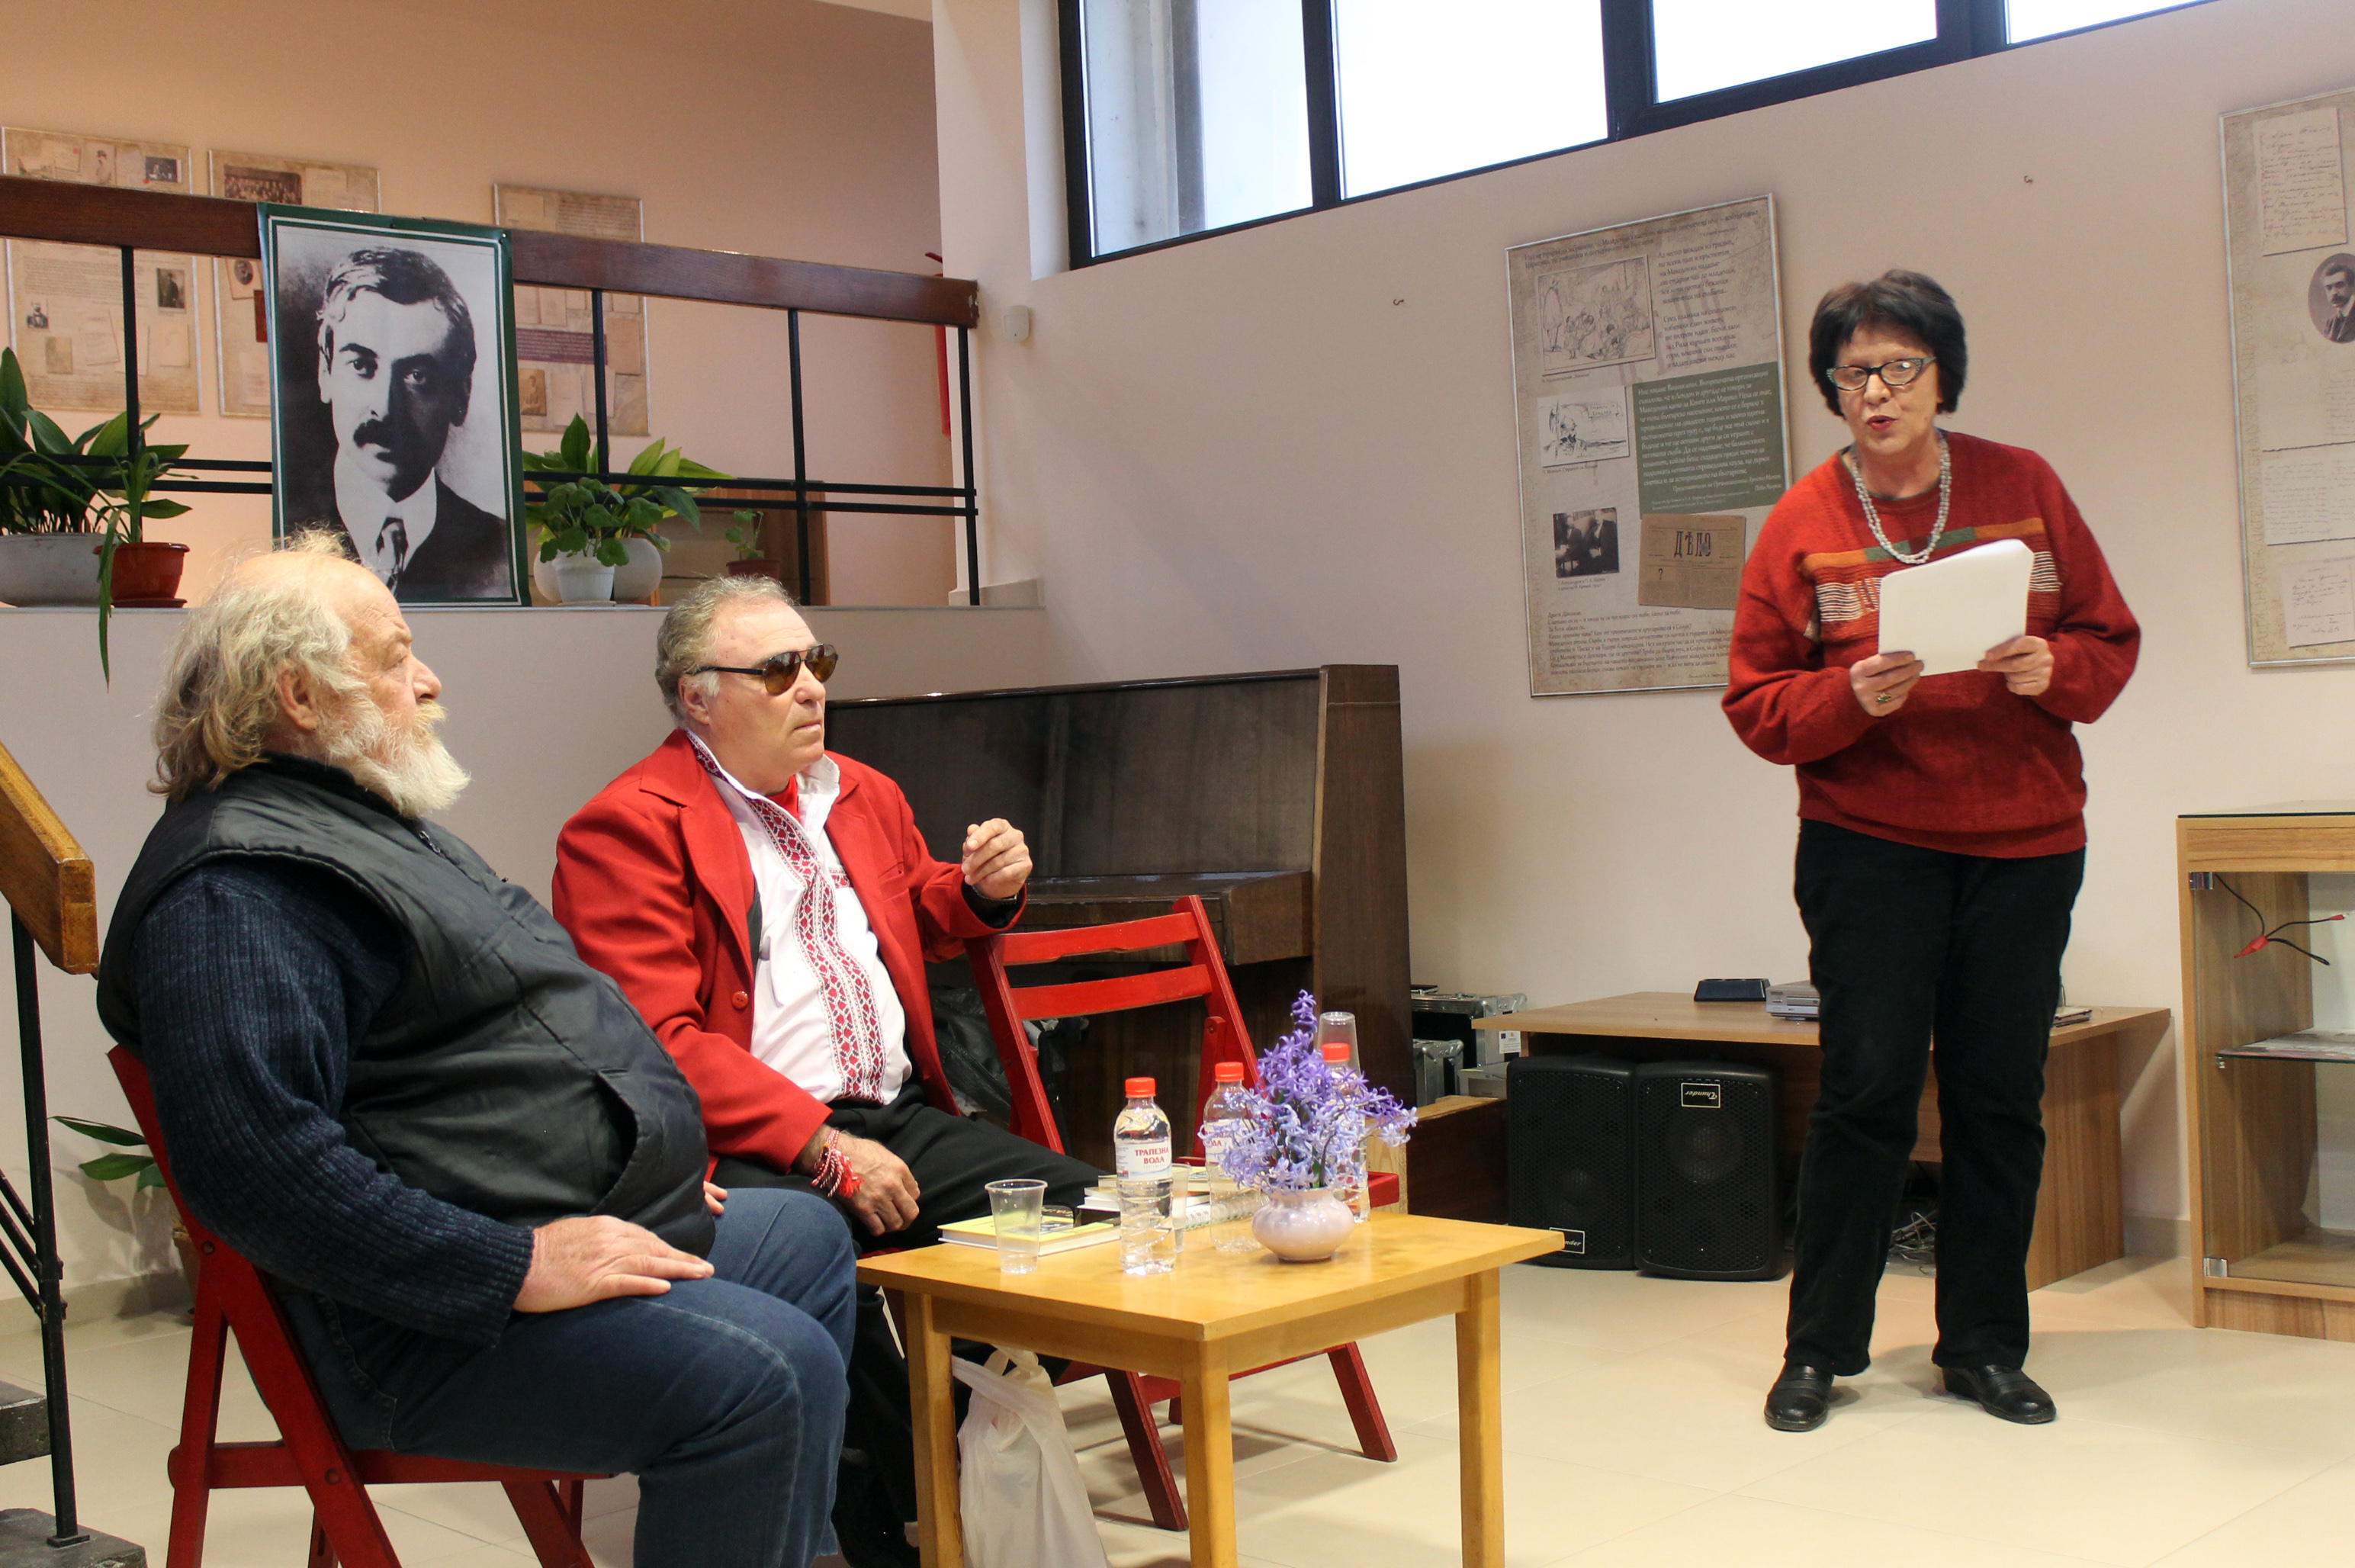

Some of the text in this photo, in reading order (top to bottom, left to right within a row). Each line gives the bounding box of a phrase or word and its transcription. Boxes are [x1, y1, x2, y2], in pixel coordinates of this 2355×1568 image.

[1685, 1091, 1717, 1100] Thunder
[1135, 1147, 1169, 1156] ТРАПЕЗНА
[1144, 1156, 1165, 1165] ВОДА
